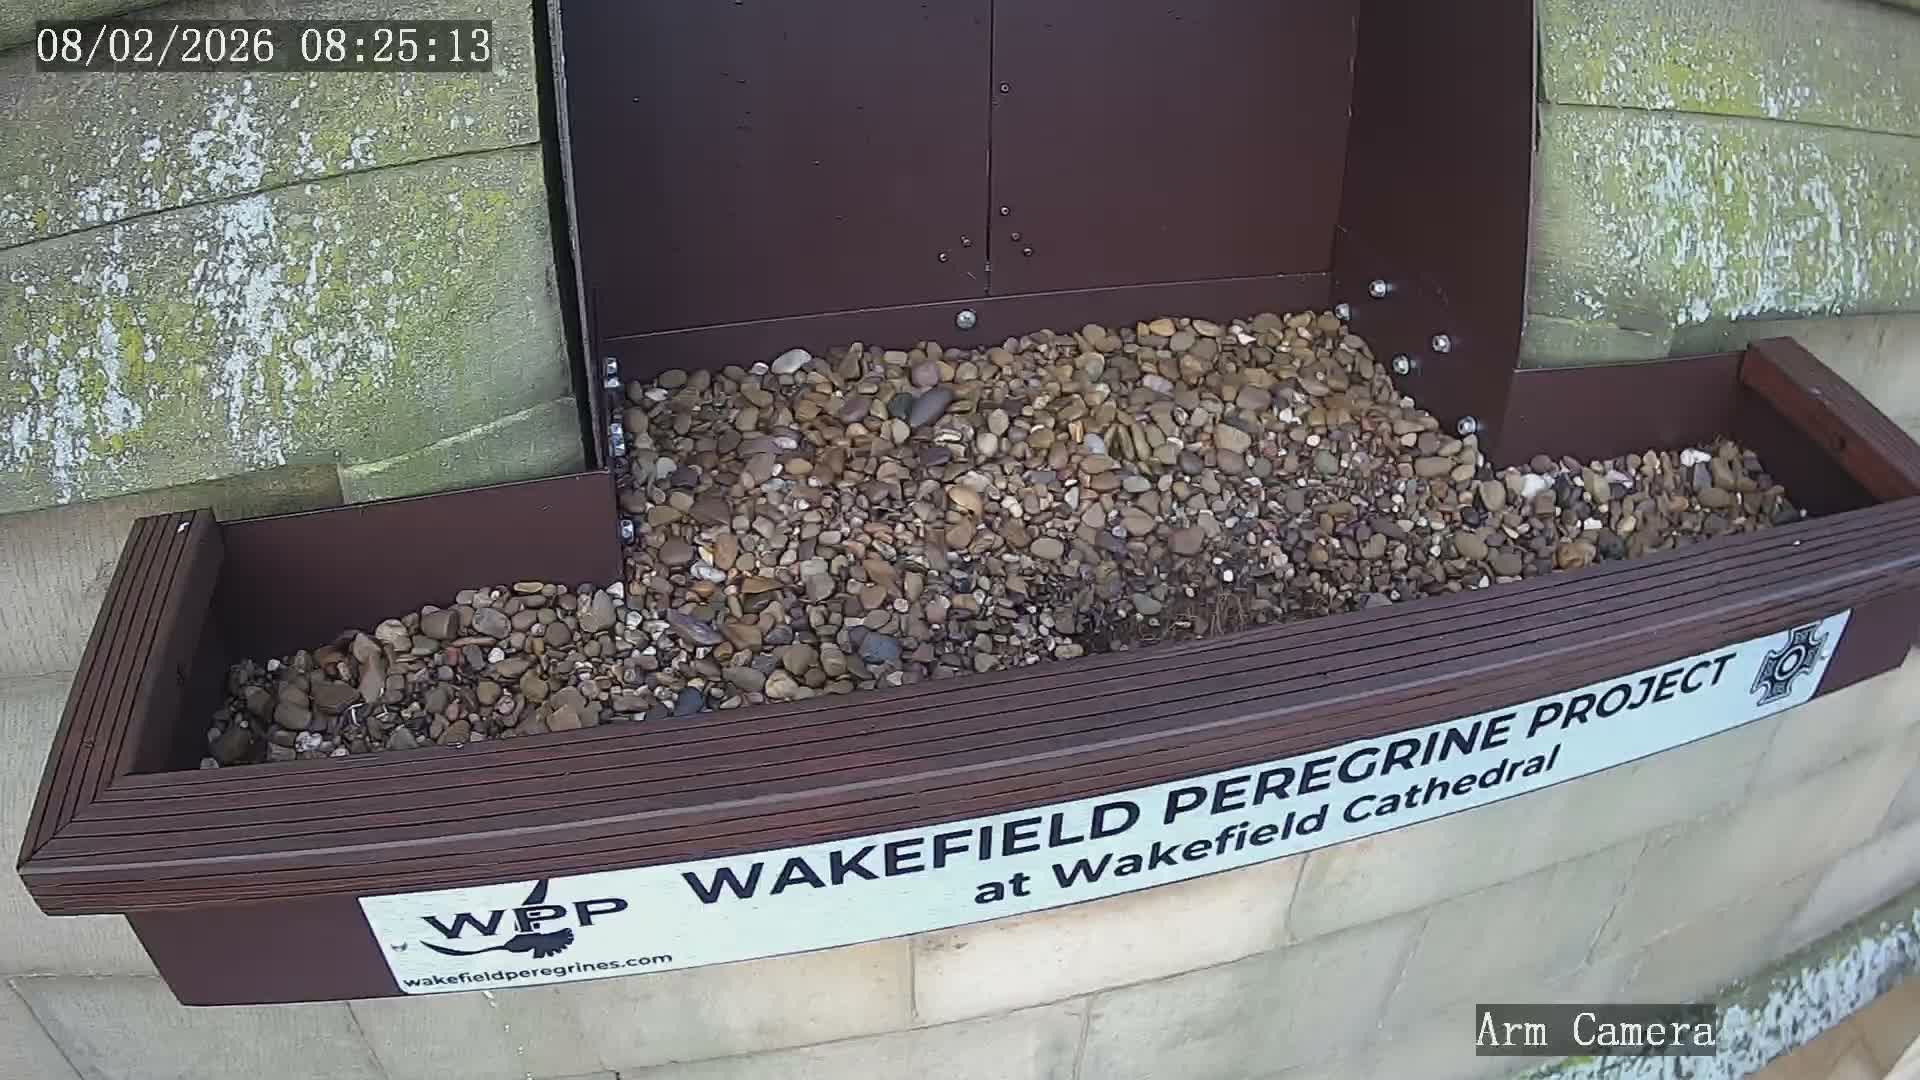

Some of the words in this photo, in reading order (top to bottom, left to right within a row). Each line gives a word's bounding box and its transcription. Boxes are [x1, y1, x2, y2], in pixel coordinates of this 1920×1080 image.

[682, 800, 1139, 904] WAKEFIELD
[1163, 713, 1517, 824] PEREGRINE
[1526, 653, 1737, 738] PROJECT
[974, 872, 1031, 904] at
[1052, 807, 1327, 889] Wakefield
[1343, 744, 1561, 824] Cathedral
[420, 897, 629, 939] WPP
[403, 952, 673, 988] wakefieldperegrines.com
